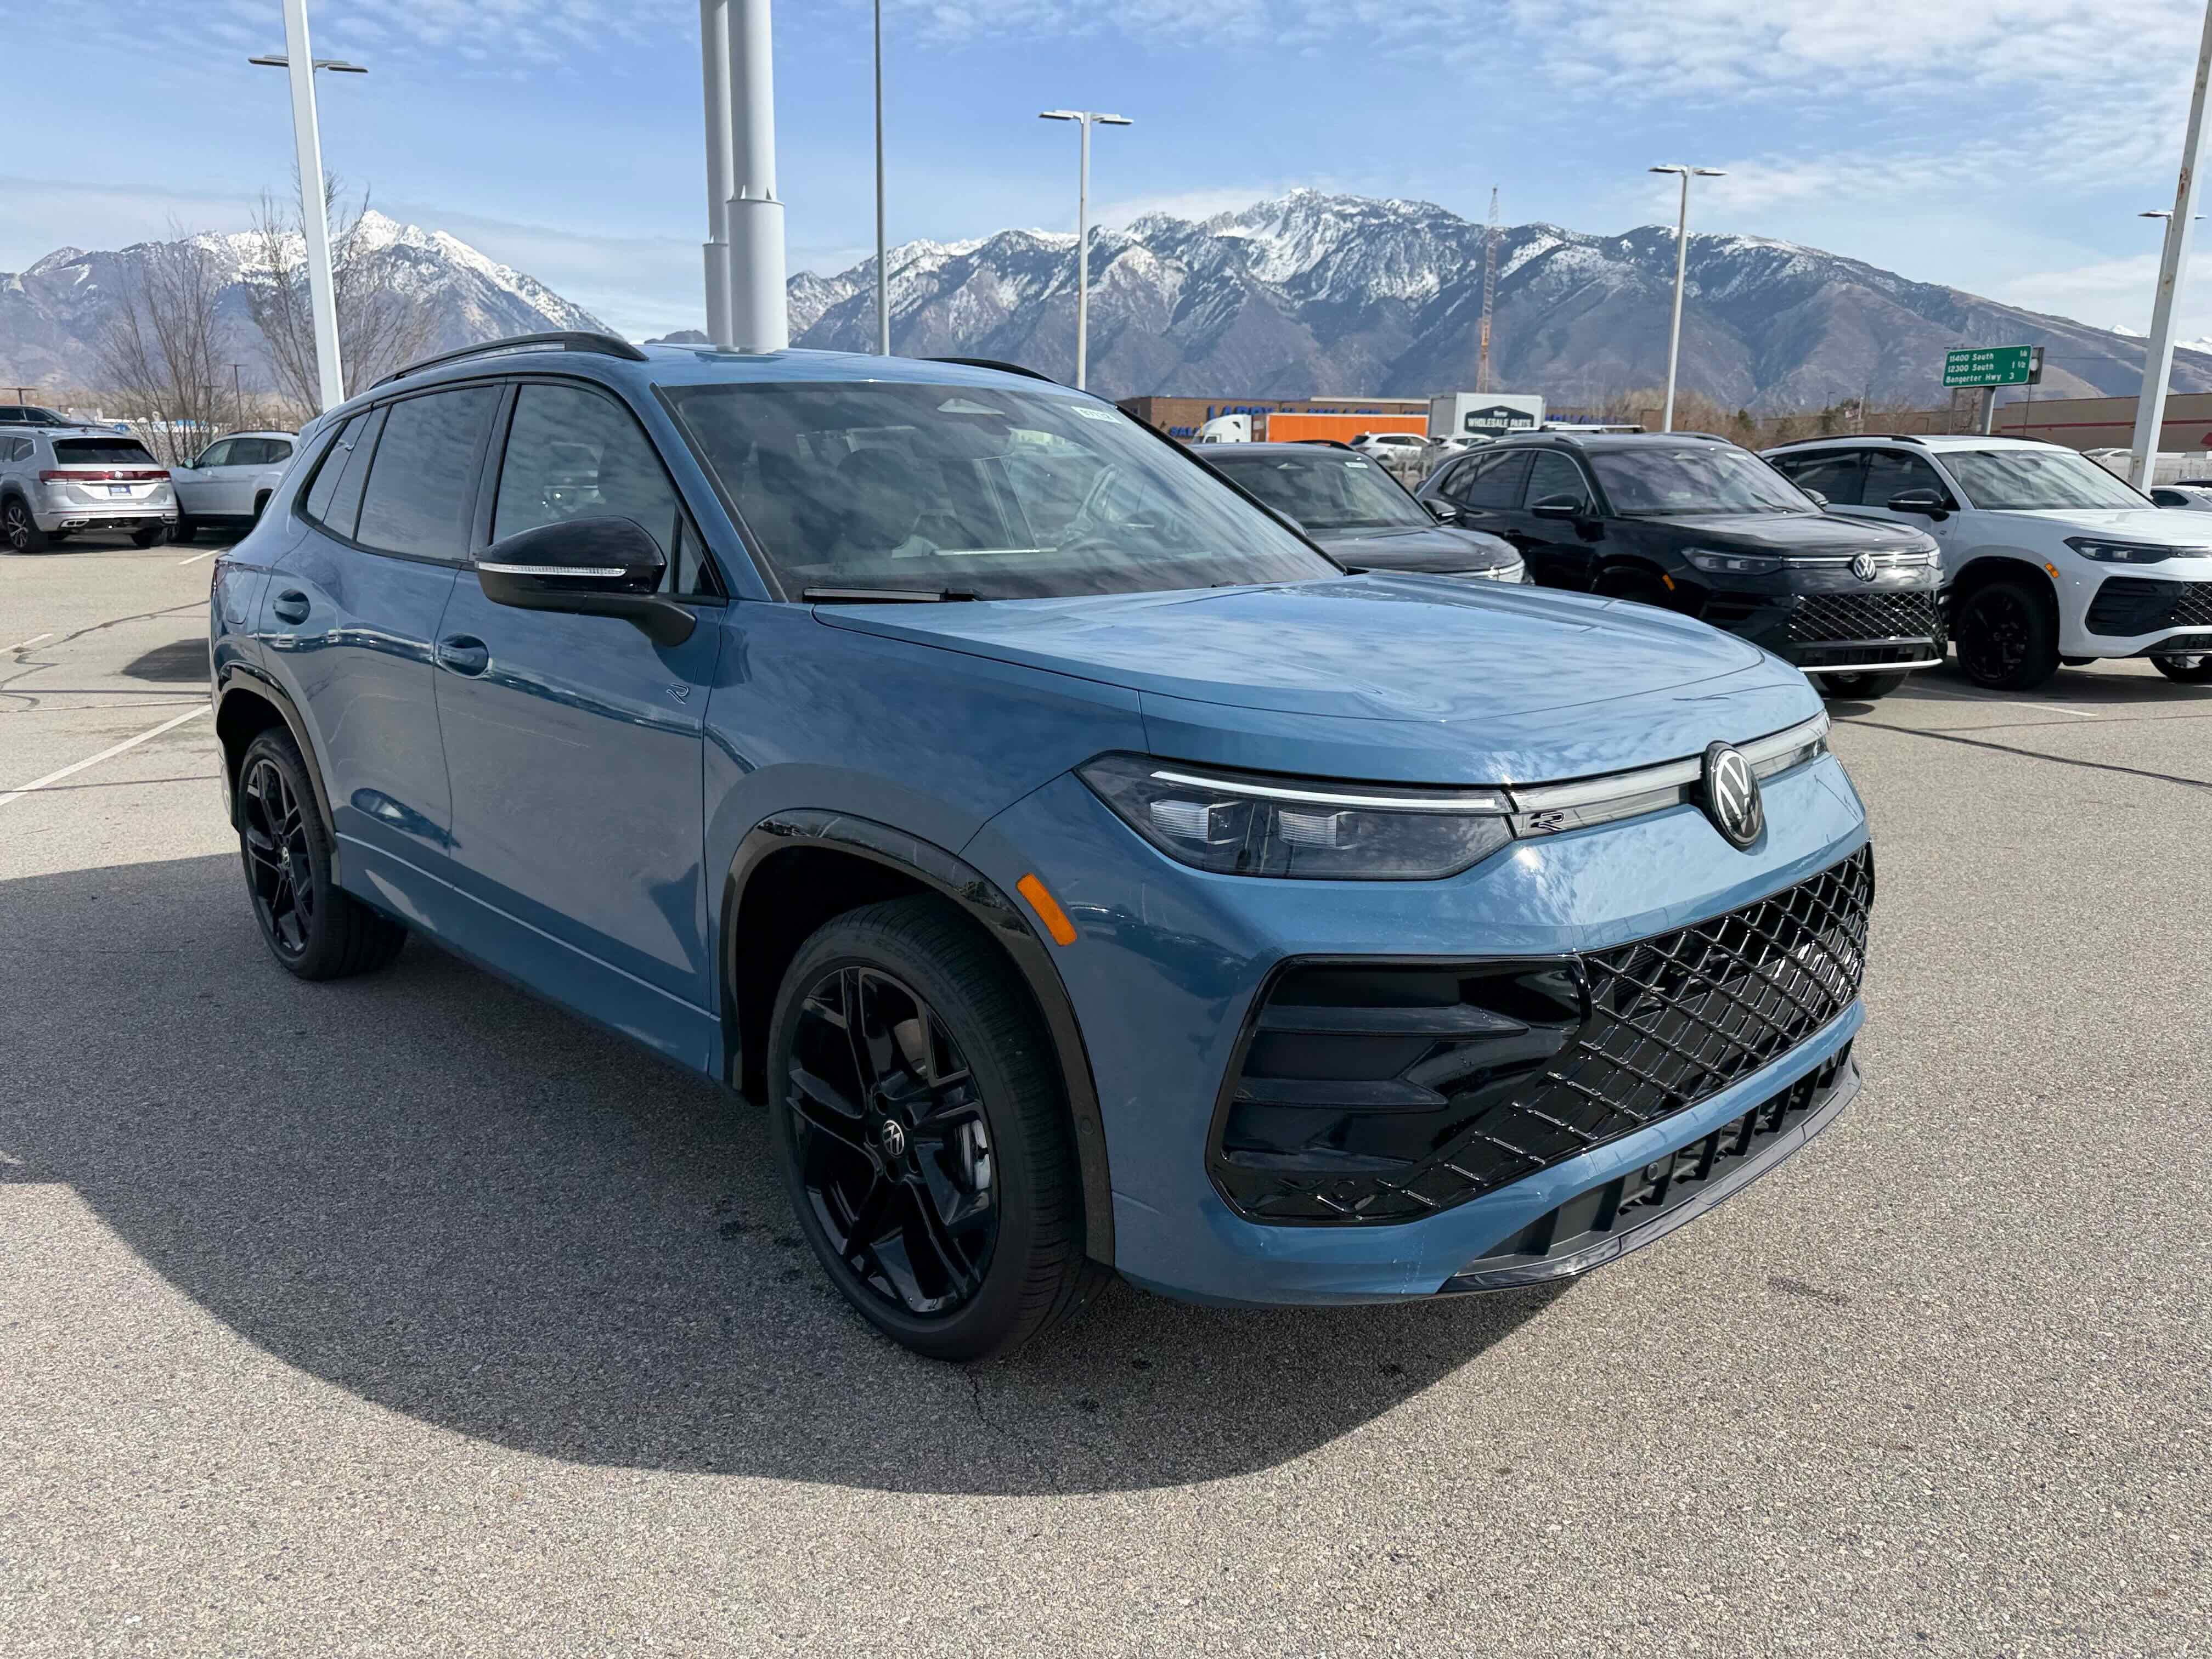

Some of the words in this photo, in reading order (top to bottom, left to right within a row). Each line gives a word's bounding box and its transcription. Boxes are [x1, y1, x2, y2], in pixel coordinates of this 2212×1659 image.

[1949, 354, 1970, 362] 11400
[1972, 353, 1994, 361] South
[1948, 364, 1969, 373] 12300
[1972, 363, 1994, 371] South
[1946, 375, 1982, 384] Bangerter
[1985, 373, 2002, 382] Hwy
[2009, 372, 2015, 380] 3
[1468, 417, 1509, 428] WHOLESALE
[1510, 419, 1532, 427] PARTS
